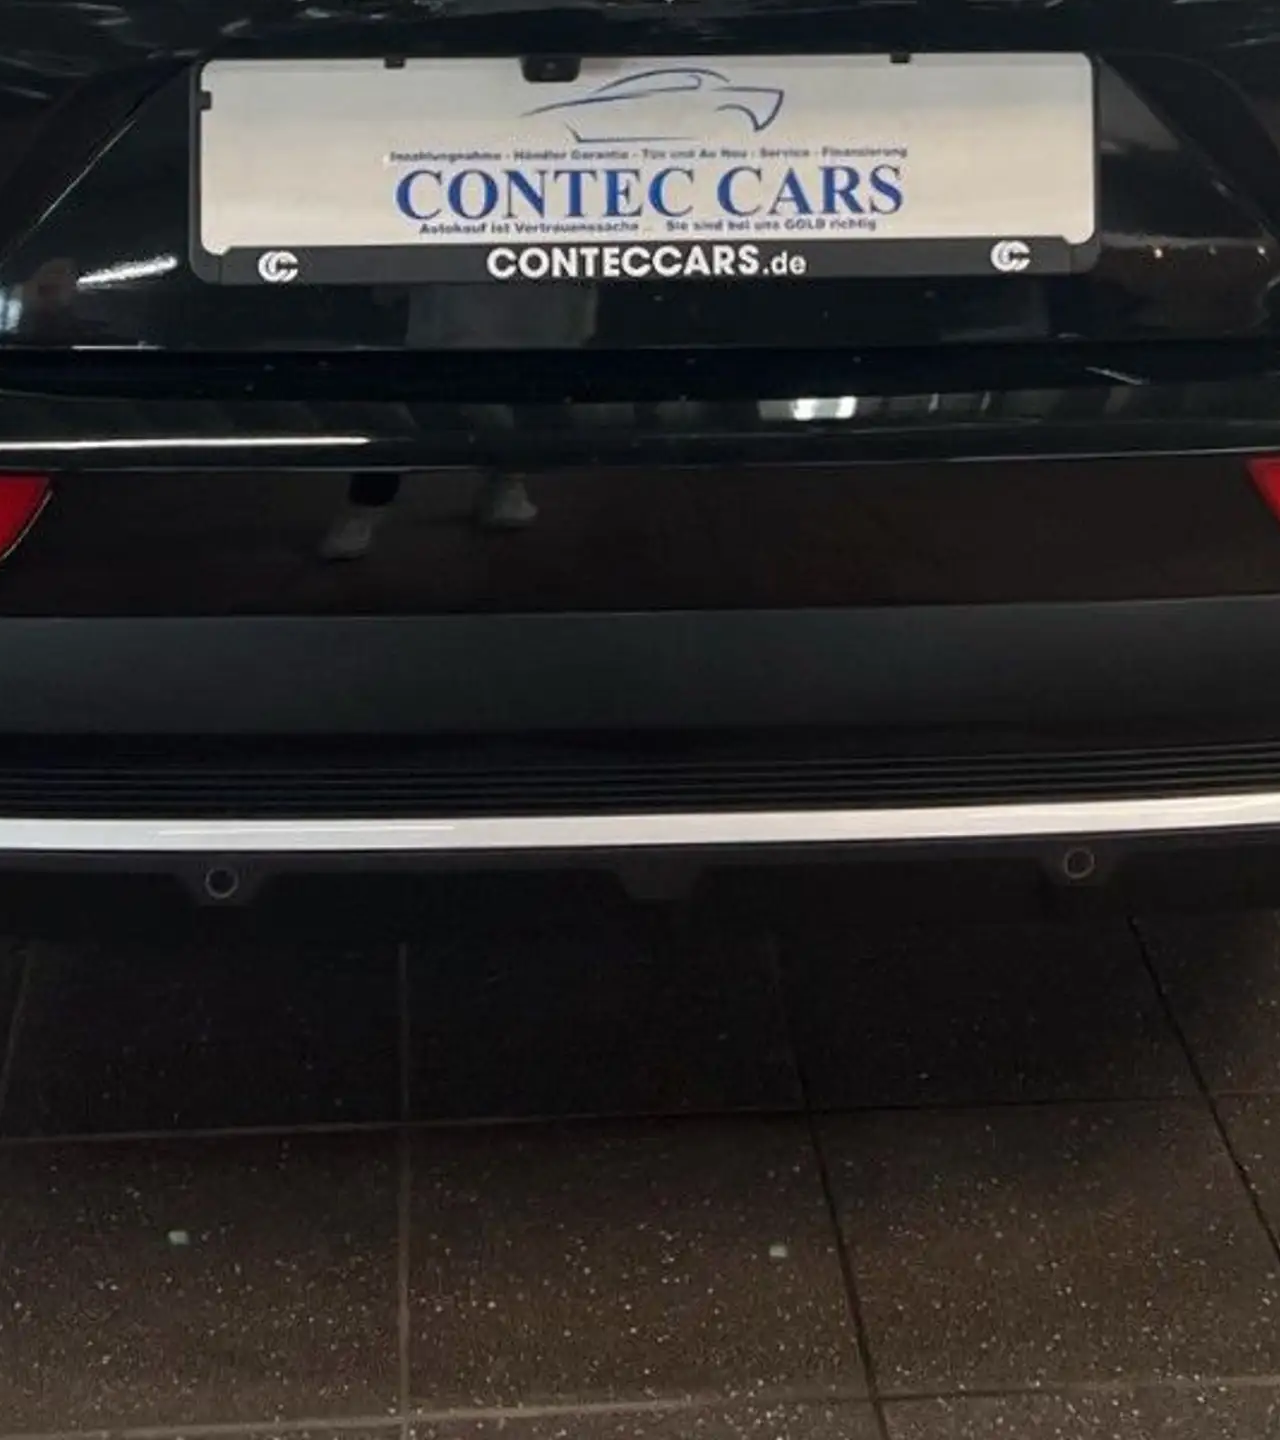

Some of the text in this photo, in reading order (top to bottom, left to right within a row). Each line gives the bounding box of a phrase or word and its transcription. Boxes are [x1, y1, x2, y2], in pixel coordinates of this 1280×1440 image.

[395, 164, 903, 220] CONTEC CARS
[486, 245, 807, 279] CONTECCARS.de
